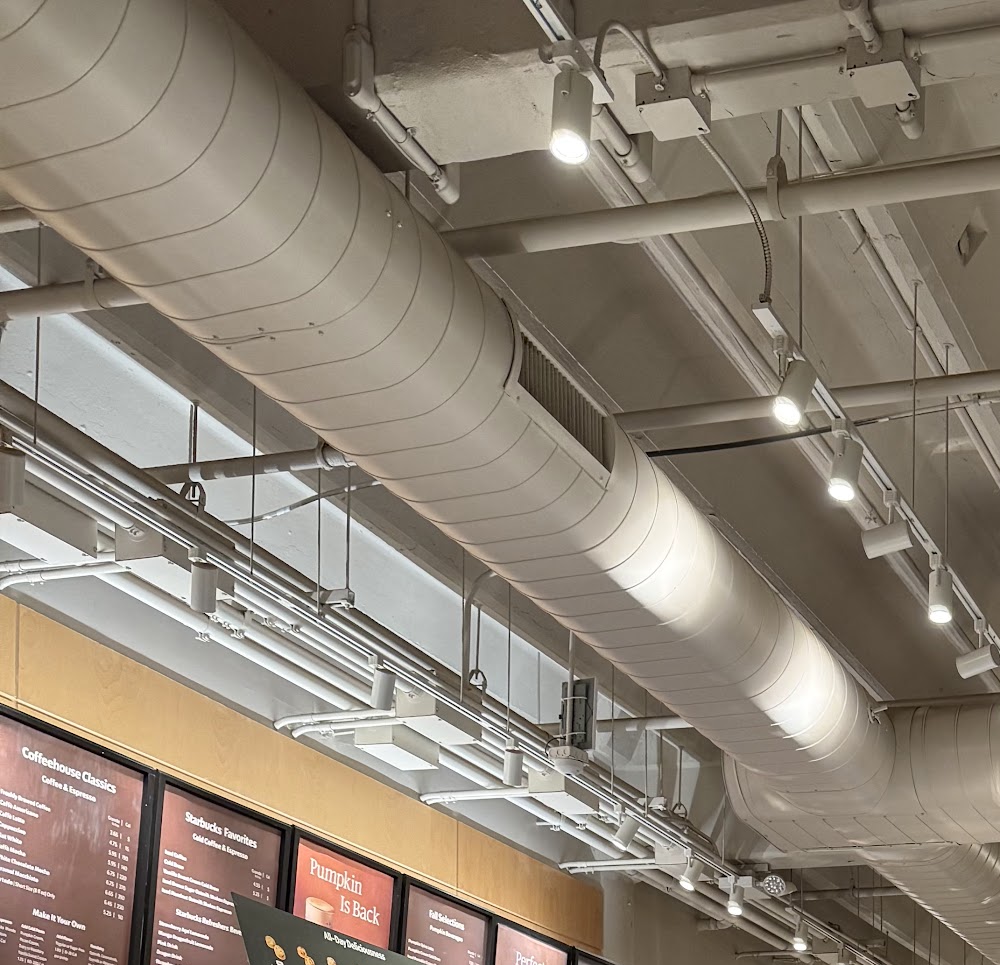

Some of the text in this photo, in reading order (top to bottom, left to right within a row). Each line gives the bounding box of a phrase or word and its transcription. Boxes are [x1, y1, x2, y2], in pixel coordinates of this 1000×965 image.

[22, 746, 116, 794] Coffeehouse Classics
[42, 775, 96, 802] Coffee & Espresso
[185, 812, 257, 848] Starbucks Favorites
[192, 833, 204, 844] Cold
[204, 838, 222, 850] Coffee
[227, 846, 248, 860] Espresso
[309, 858, 362, 896] Pumpkin
[32, 908, 51, 920] Make
[57, 916, 71, 926] Your
[72, 920, 86, 931] Own
[176, 908, 201, 923] Starbucks
[340, 896, 380, 926] Is Back
[429, 909, 464, 931] Fall Selections
[324, 931, 386, 961] All-Day Deliciousness
